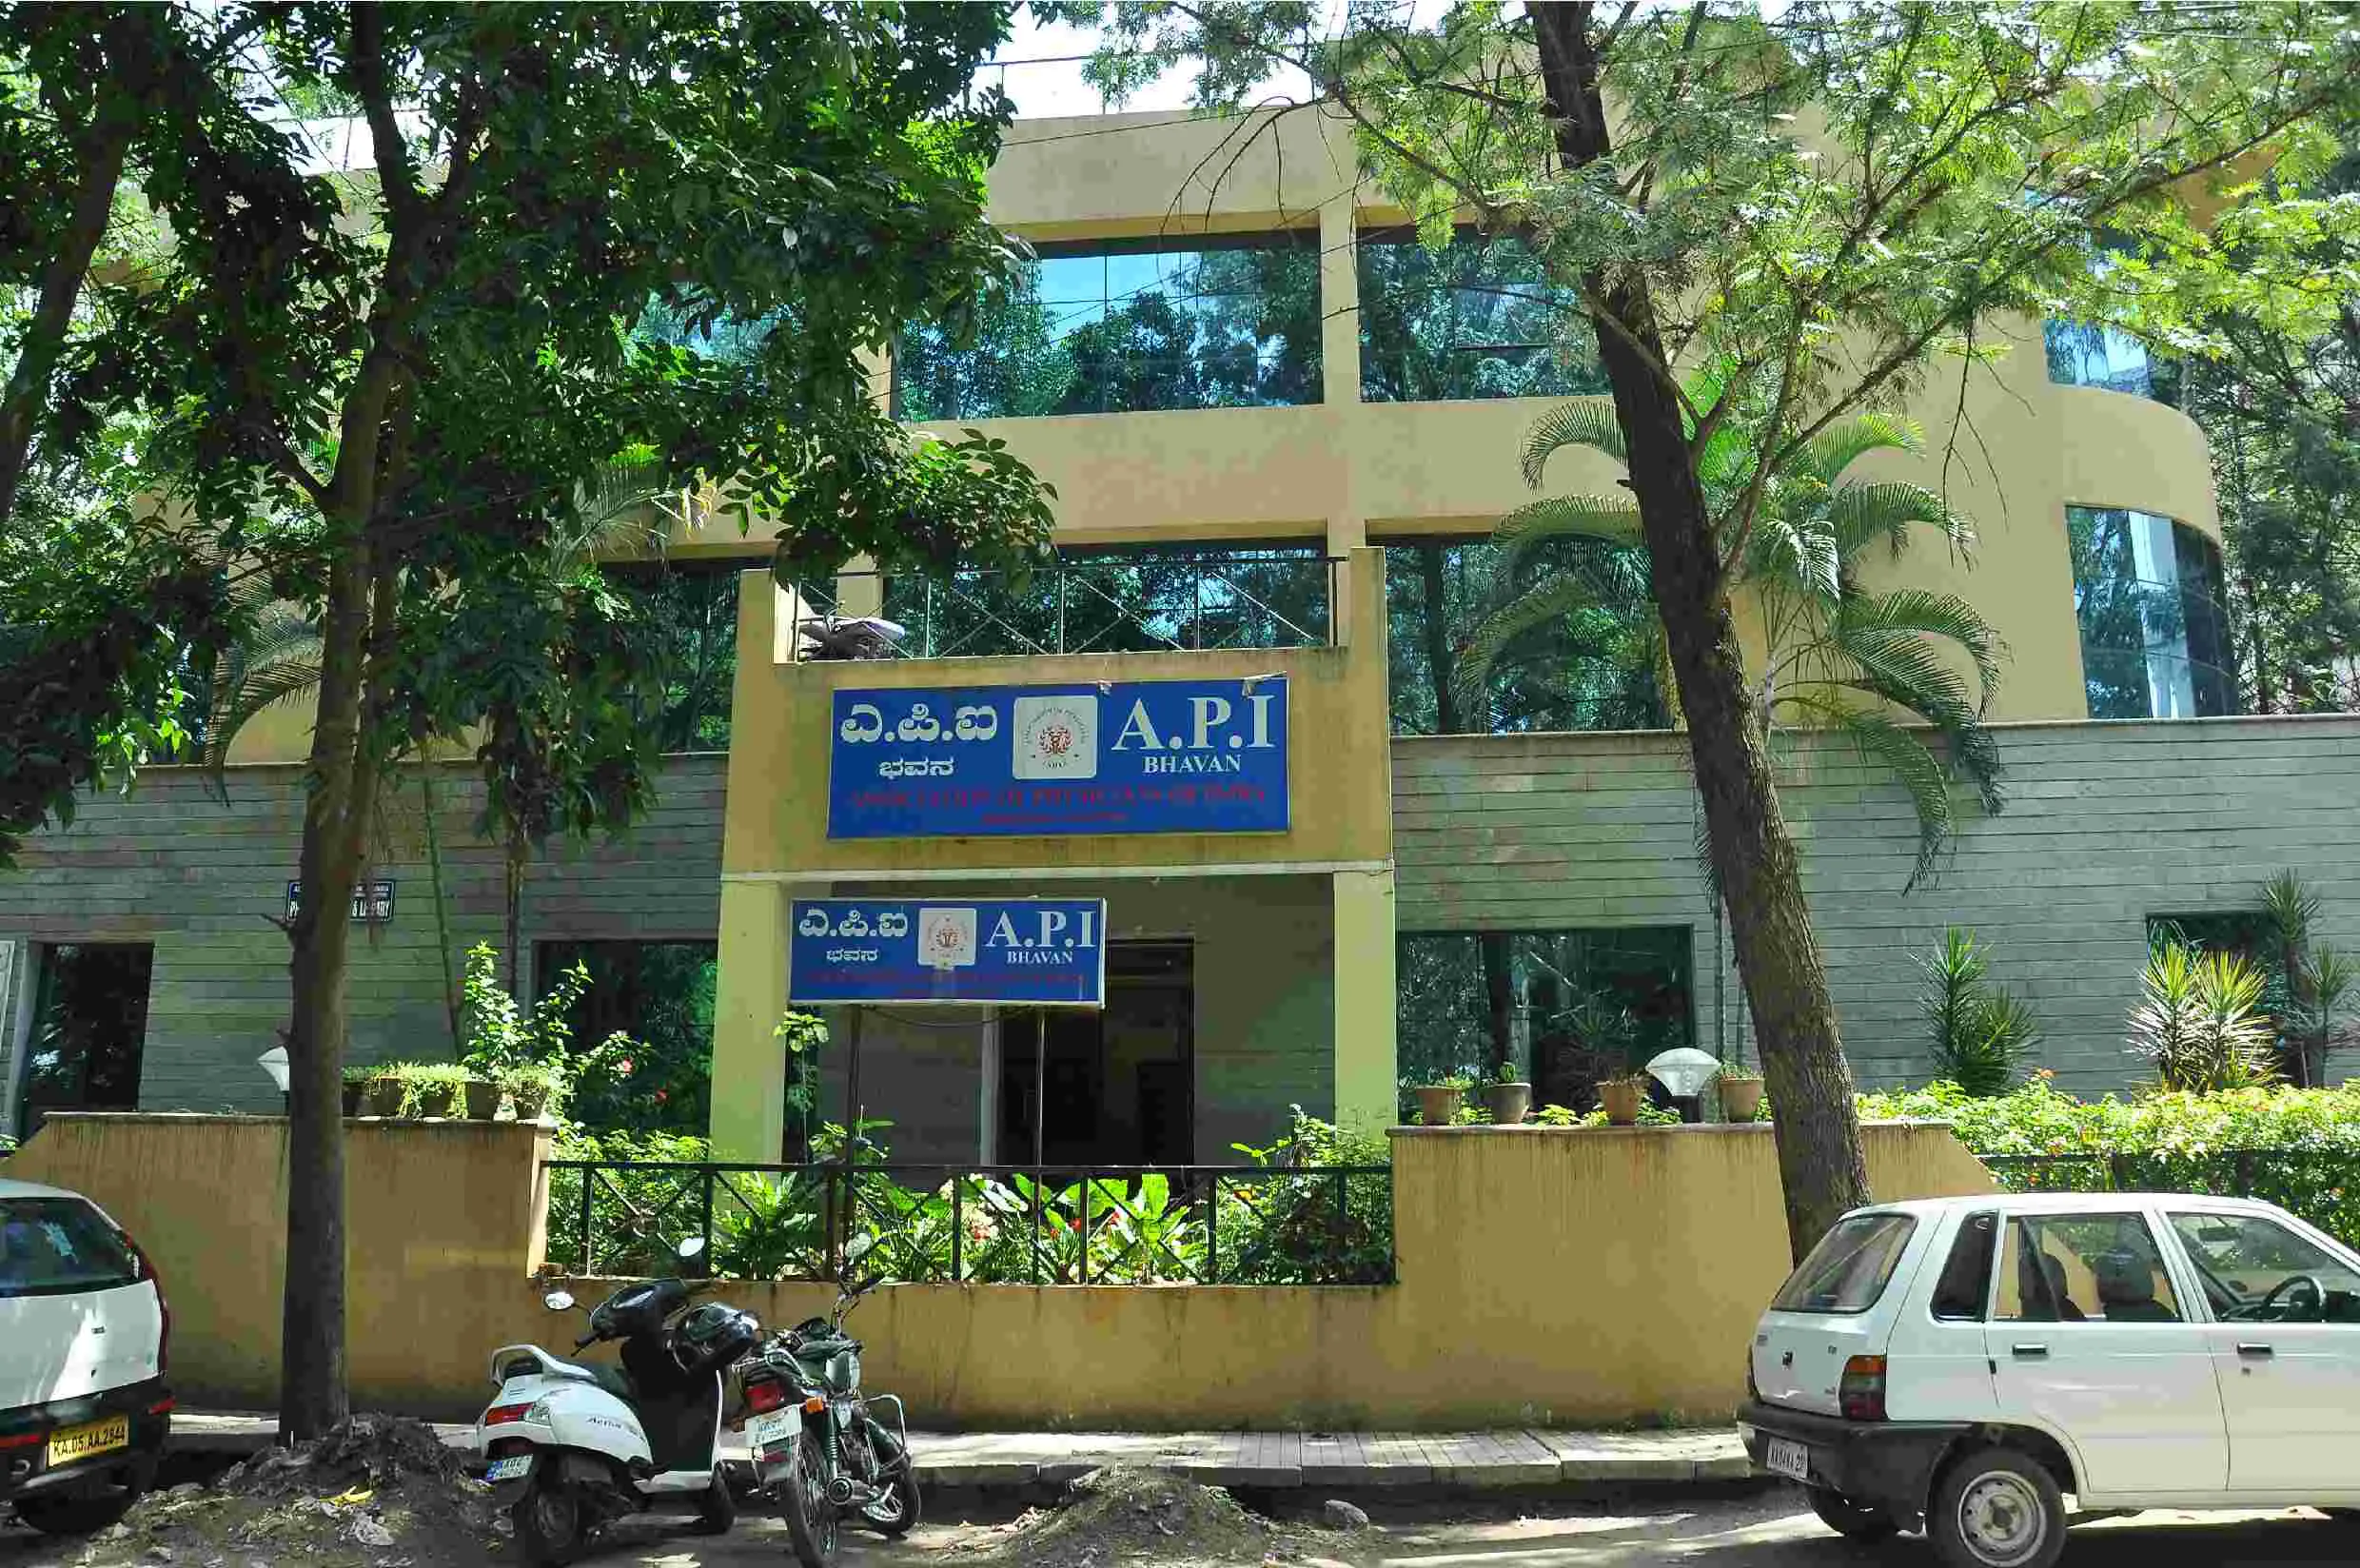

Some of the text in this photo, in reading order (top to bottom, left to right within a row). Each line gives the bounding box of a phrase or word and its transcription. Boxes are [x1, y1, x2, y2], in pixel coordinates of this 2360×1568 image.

[1111, 694, 1276, 751] A.P.I
[878, 757, 954, 779] ಭವನ
[1142, 754, 1242, 774] BHAVAN
[359, 899, 390, 917] LIARY
[982, 910, 1097, 948] A.P.I
[1006, 950, 1073, 965] BHAVAN
